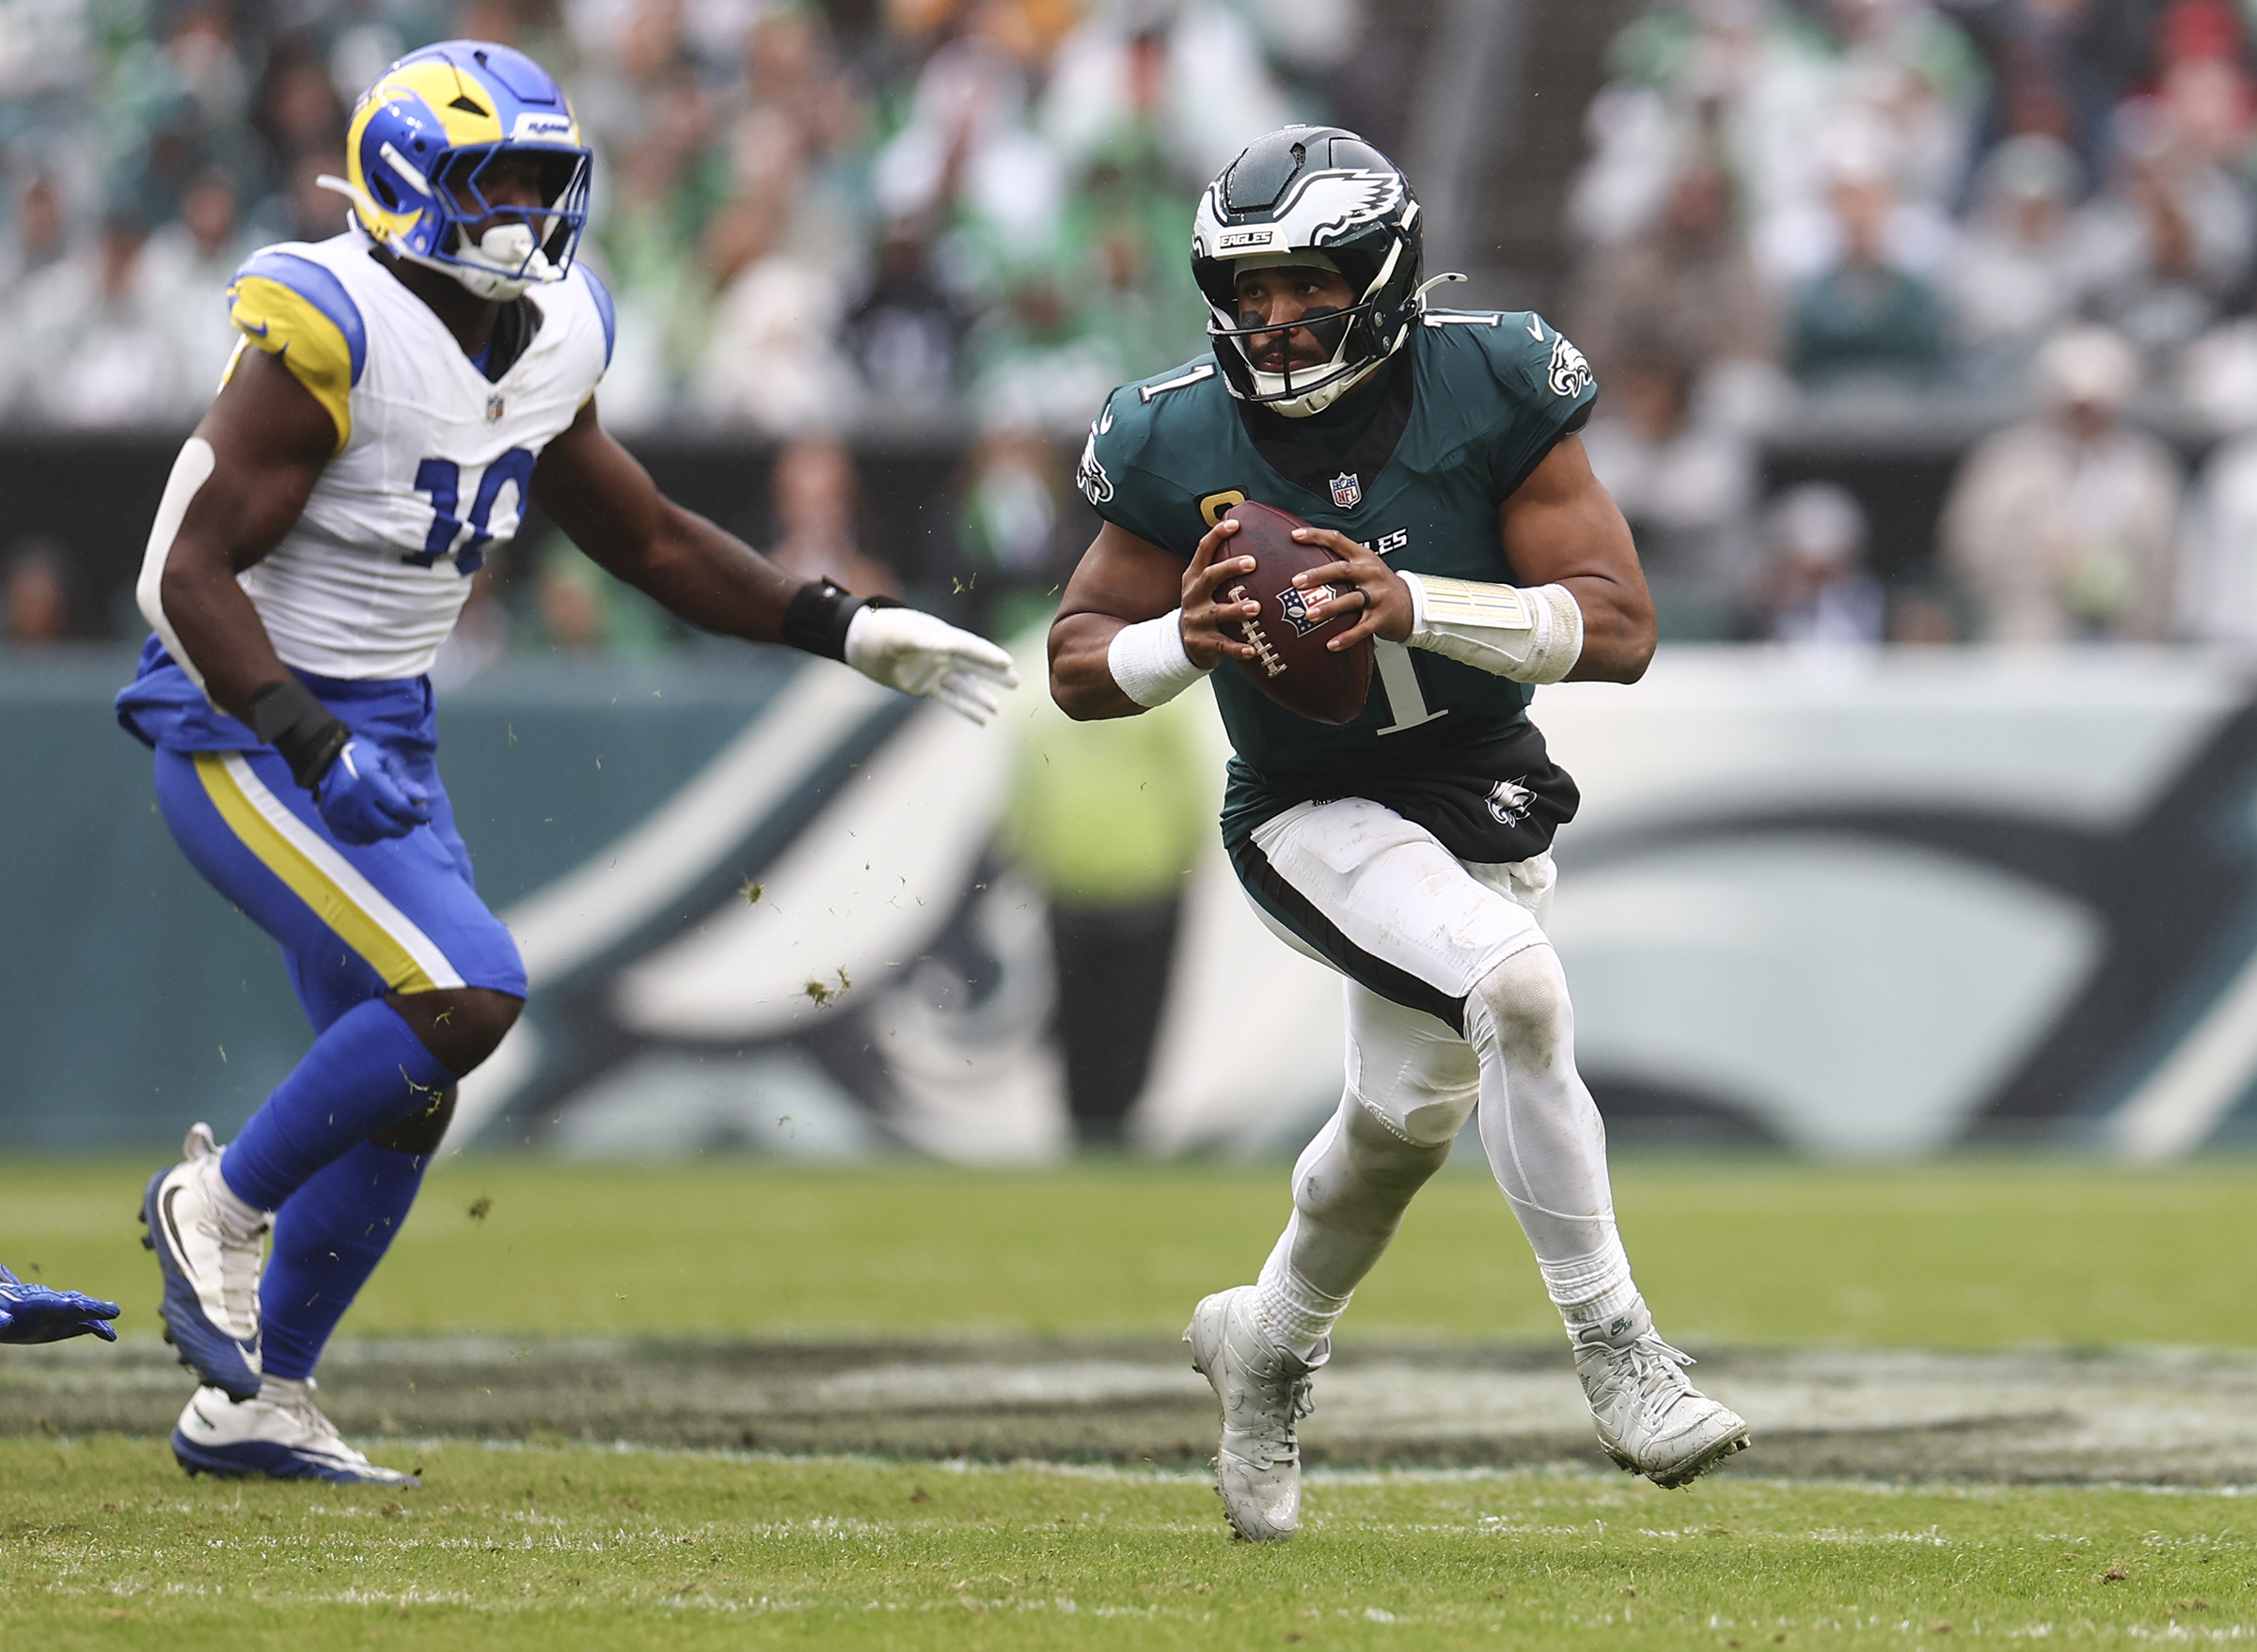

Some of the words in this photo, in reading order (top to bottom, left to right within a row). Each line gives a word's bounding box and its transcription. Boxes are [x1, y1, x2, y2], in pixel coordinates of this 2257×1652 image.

[1220, 231, 1272, 248] EAGLES
[1424, 314, 1501, 327] 1
[1138, 363, 1216, 403] 1
[1336, 488, 1357, 503] NFL
